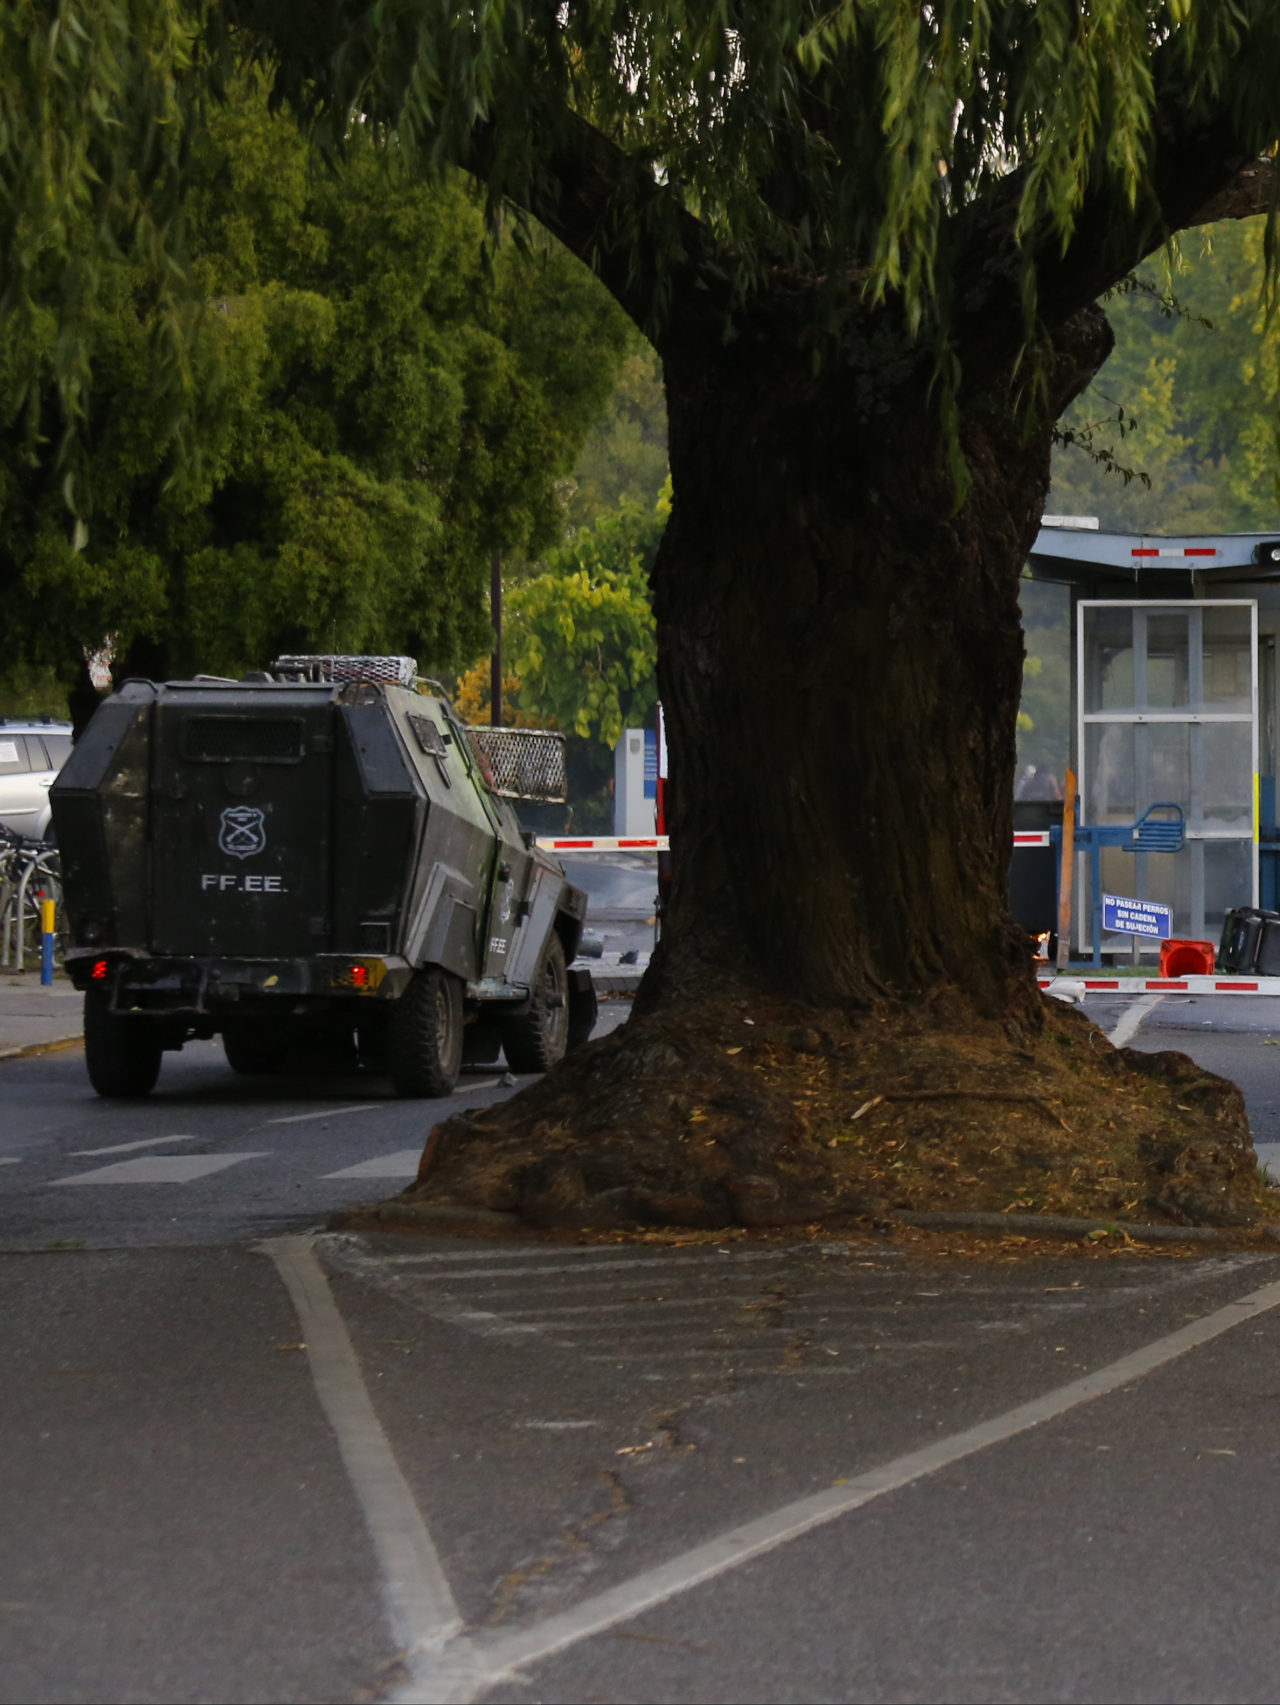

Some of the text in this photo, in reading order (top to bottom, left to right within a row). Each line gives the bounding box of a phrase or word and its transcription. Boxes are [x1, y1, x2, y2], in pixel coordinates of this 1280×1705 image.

[1105, 897, 1169, 916] NO PASEAR PERROS
[1117, 909, 1157, 924] SIN CADENA
[1115, 919, 1159, 935] DE SUJECIÓN
